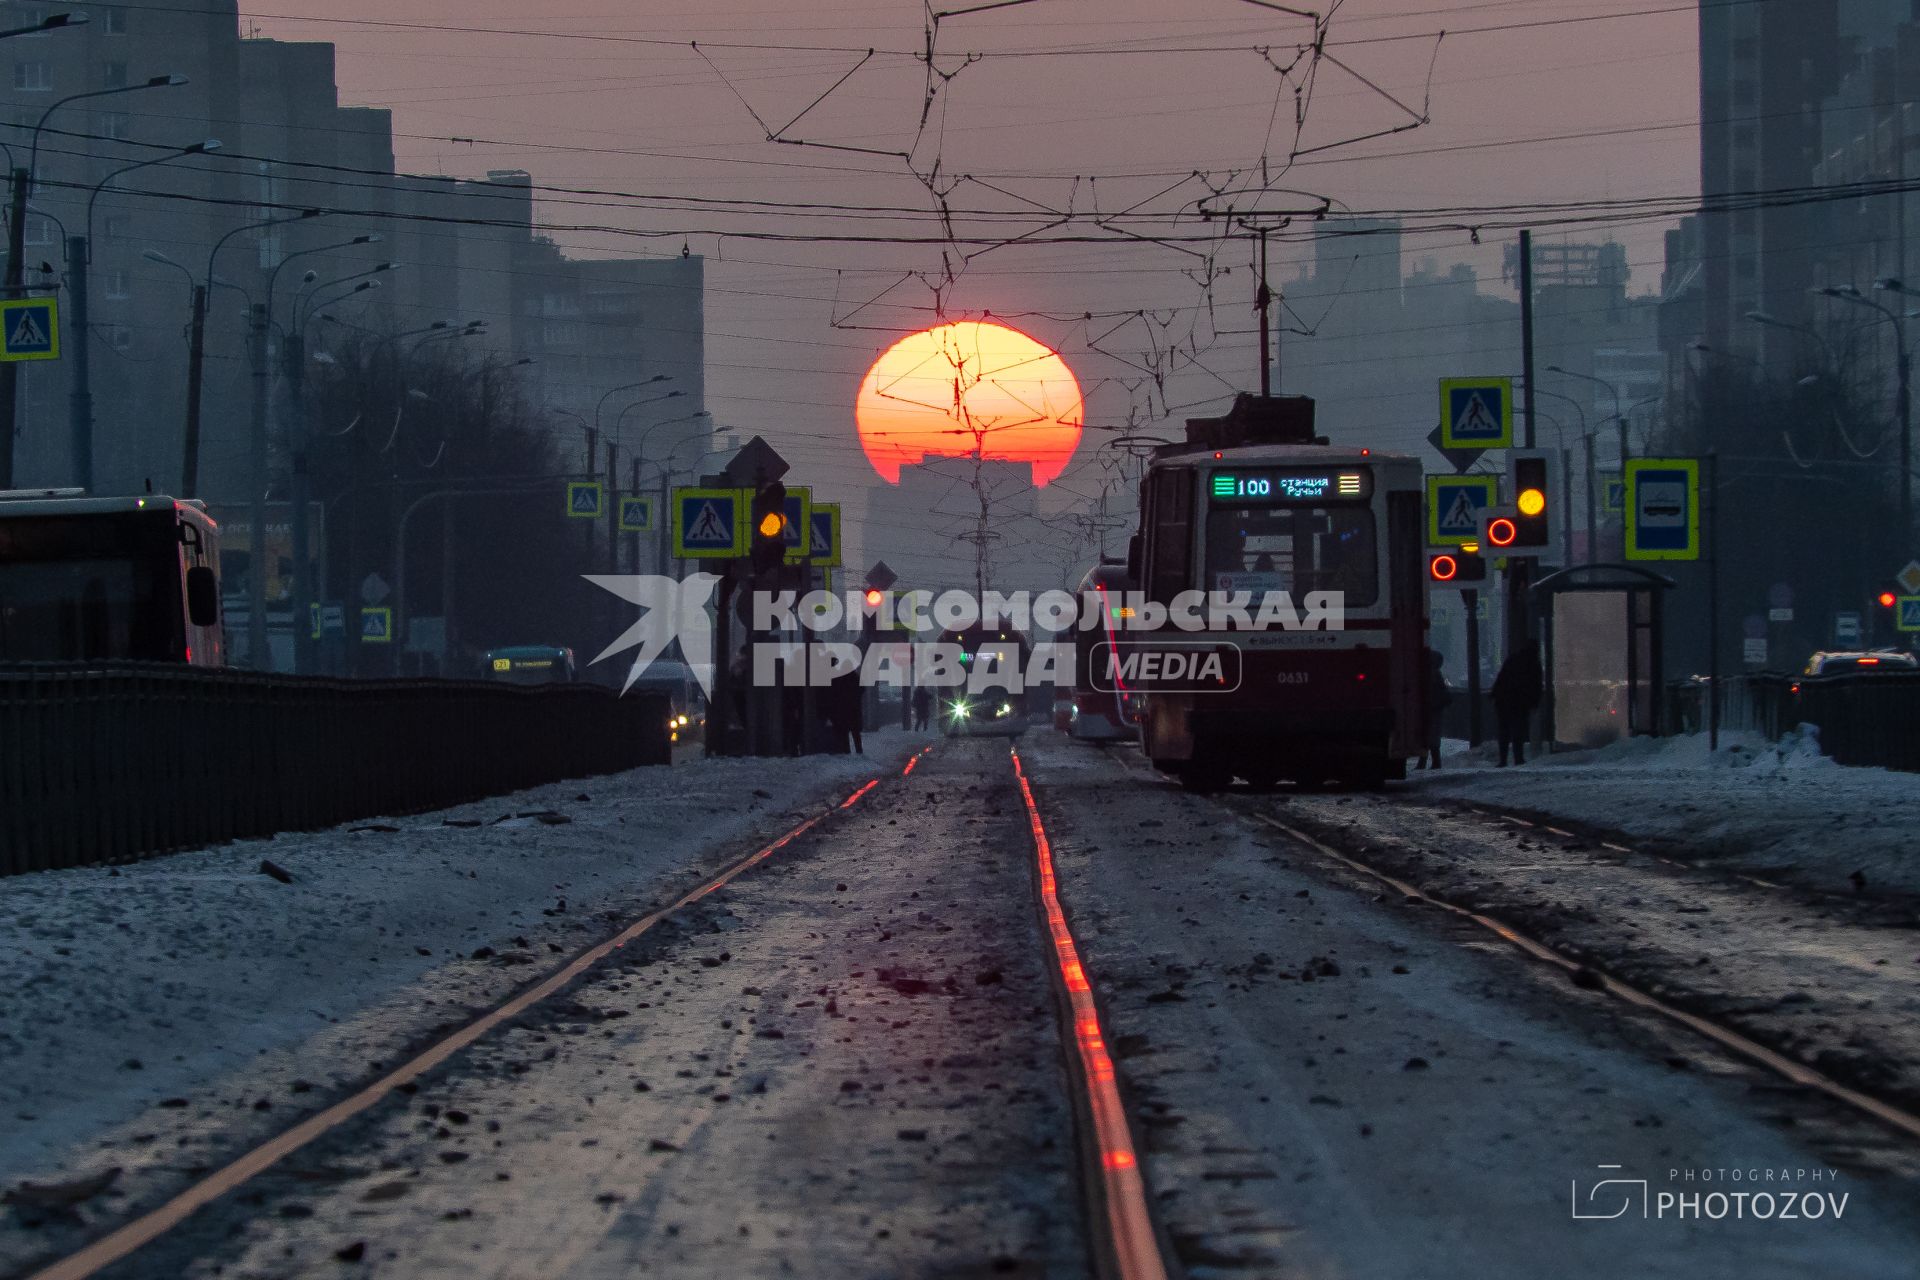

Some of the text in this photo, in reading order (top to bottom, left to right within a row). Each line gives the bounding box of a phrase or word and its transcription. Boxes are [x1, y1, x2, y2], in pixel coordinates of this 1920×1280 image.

[1237, 479, 1270, 496] 100
[1280, 478, 1329, 488] станция
[1287, 487, 1322, 496] Ручьи
[1278, 671, 1309, 684] 0631
